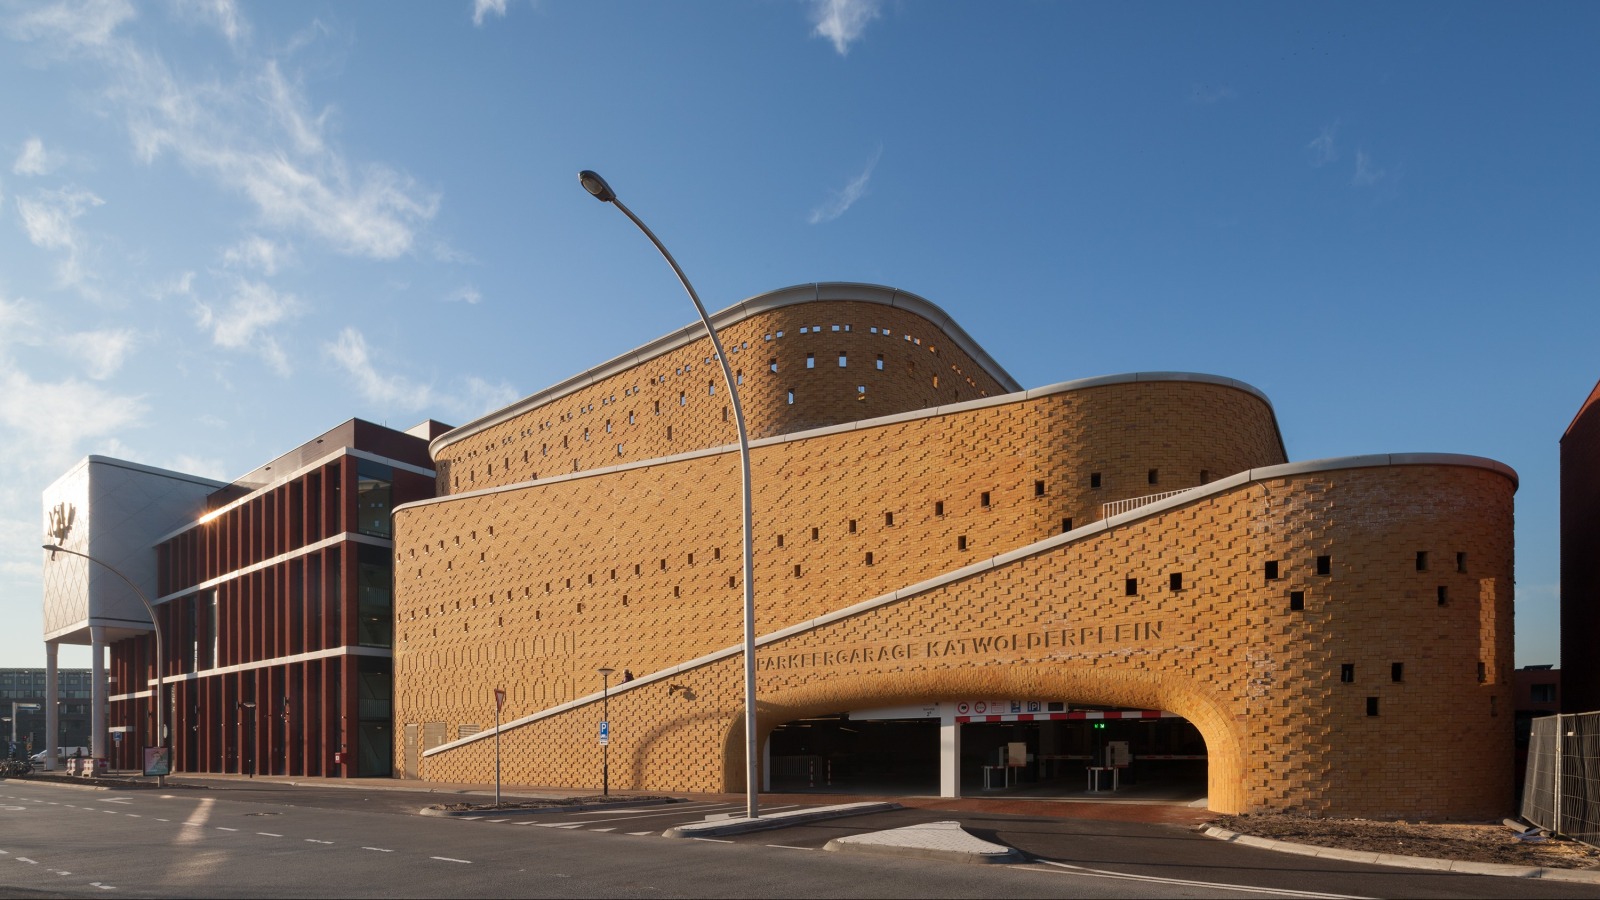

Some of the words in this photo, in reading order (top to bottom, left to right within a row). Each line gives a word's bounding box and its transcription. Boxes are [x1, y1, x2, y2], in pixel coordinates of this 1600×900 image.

[756, 643, 919, 671] PARKEERGARAGE
[927, 621, 1163, 658] KATWOLDERPLEIN
[601, 723, 606, 733] P
